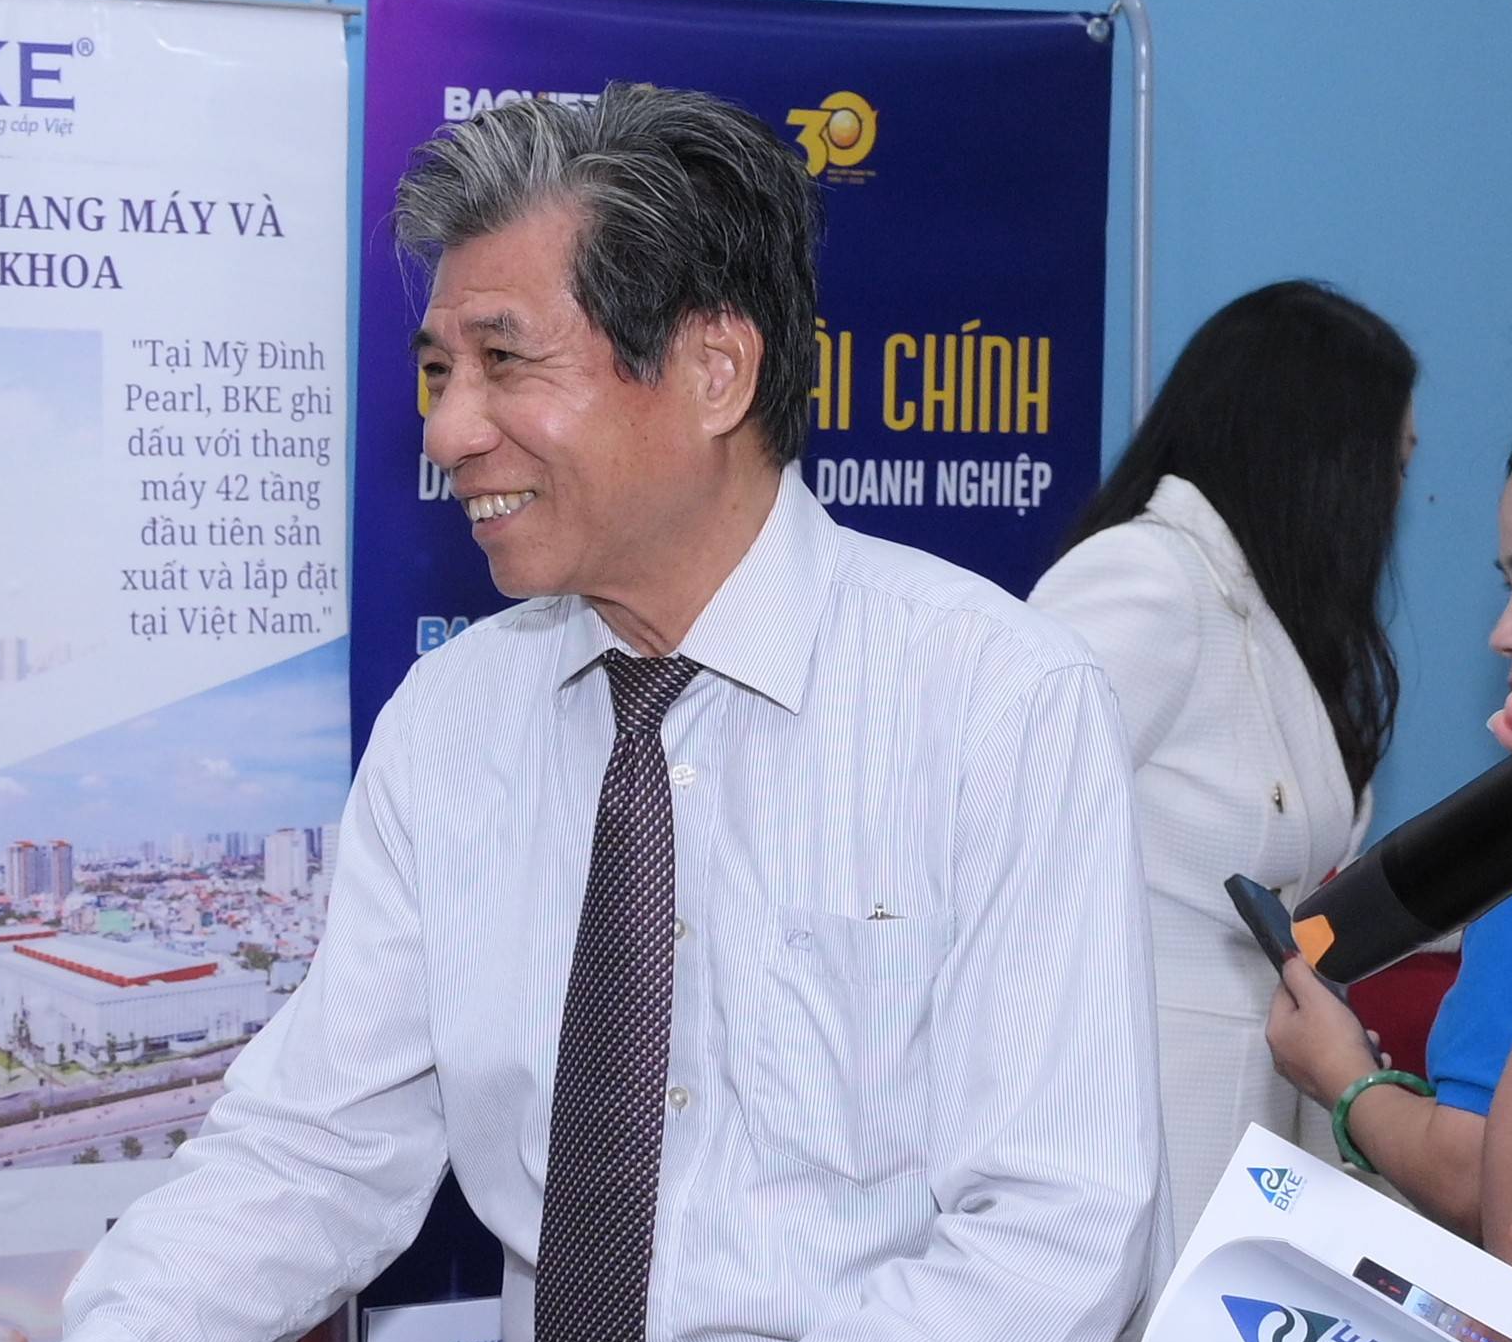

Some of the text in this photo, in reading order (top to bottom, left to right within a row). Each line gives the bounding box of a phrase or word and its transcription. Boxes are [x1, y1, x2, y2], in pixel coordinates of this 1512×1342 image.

[10, 114, 40, 137] cấp
[44, 116, 75, 138] Việt
[118, 189, 217, 236] MÁY
[228, 192, 286, 238] VÀ
[132, 338, 327, 377] "Tại Mỹ Đình
[810, 317, 1051, 435] ÀI CHÍNH
[125, 383, 334, 422] Pearl, BKE ghi
[128, 426, 332, 467] dấu với thang
[140, 471, 322, 511] máy 42 tầng
[816, 453, 1053, 517] DOANH NGHIỆP
[140, 515, 322, 547] đầu tiên sản
[120, 558, 340, 599] xuất và lắp đặt
[129, 605, 334, 641] tại Việt Nam."
[1275, 1169, 1304, 1212] BKE
